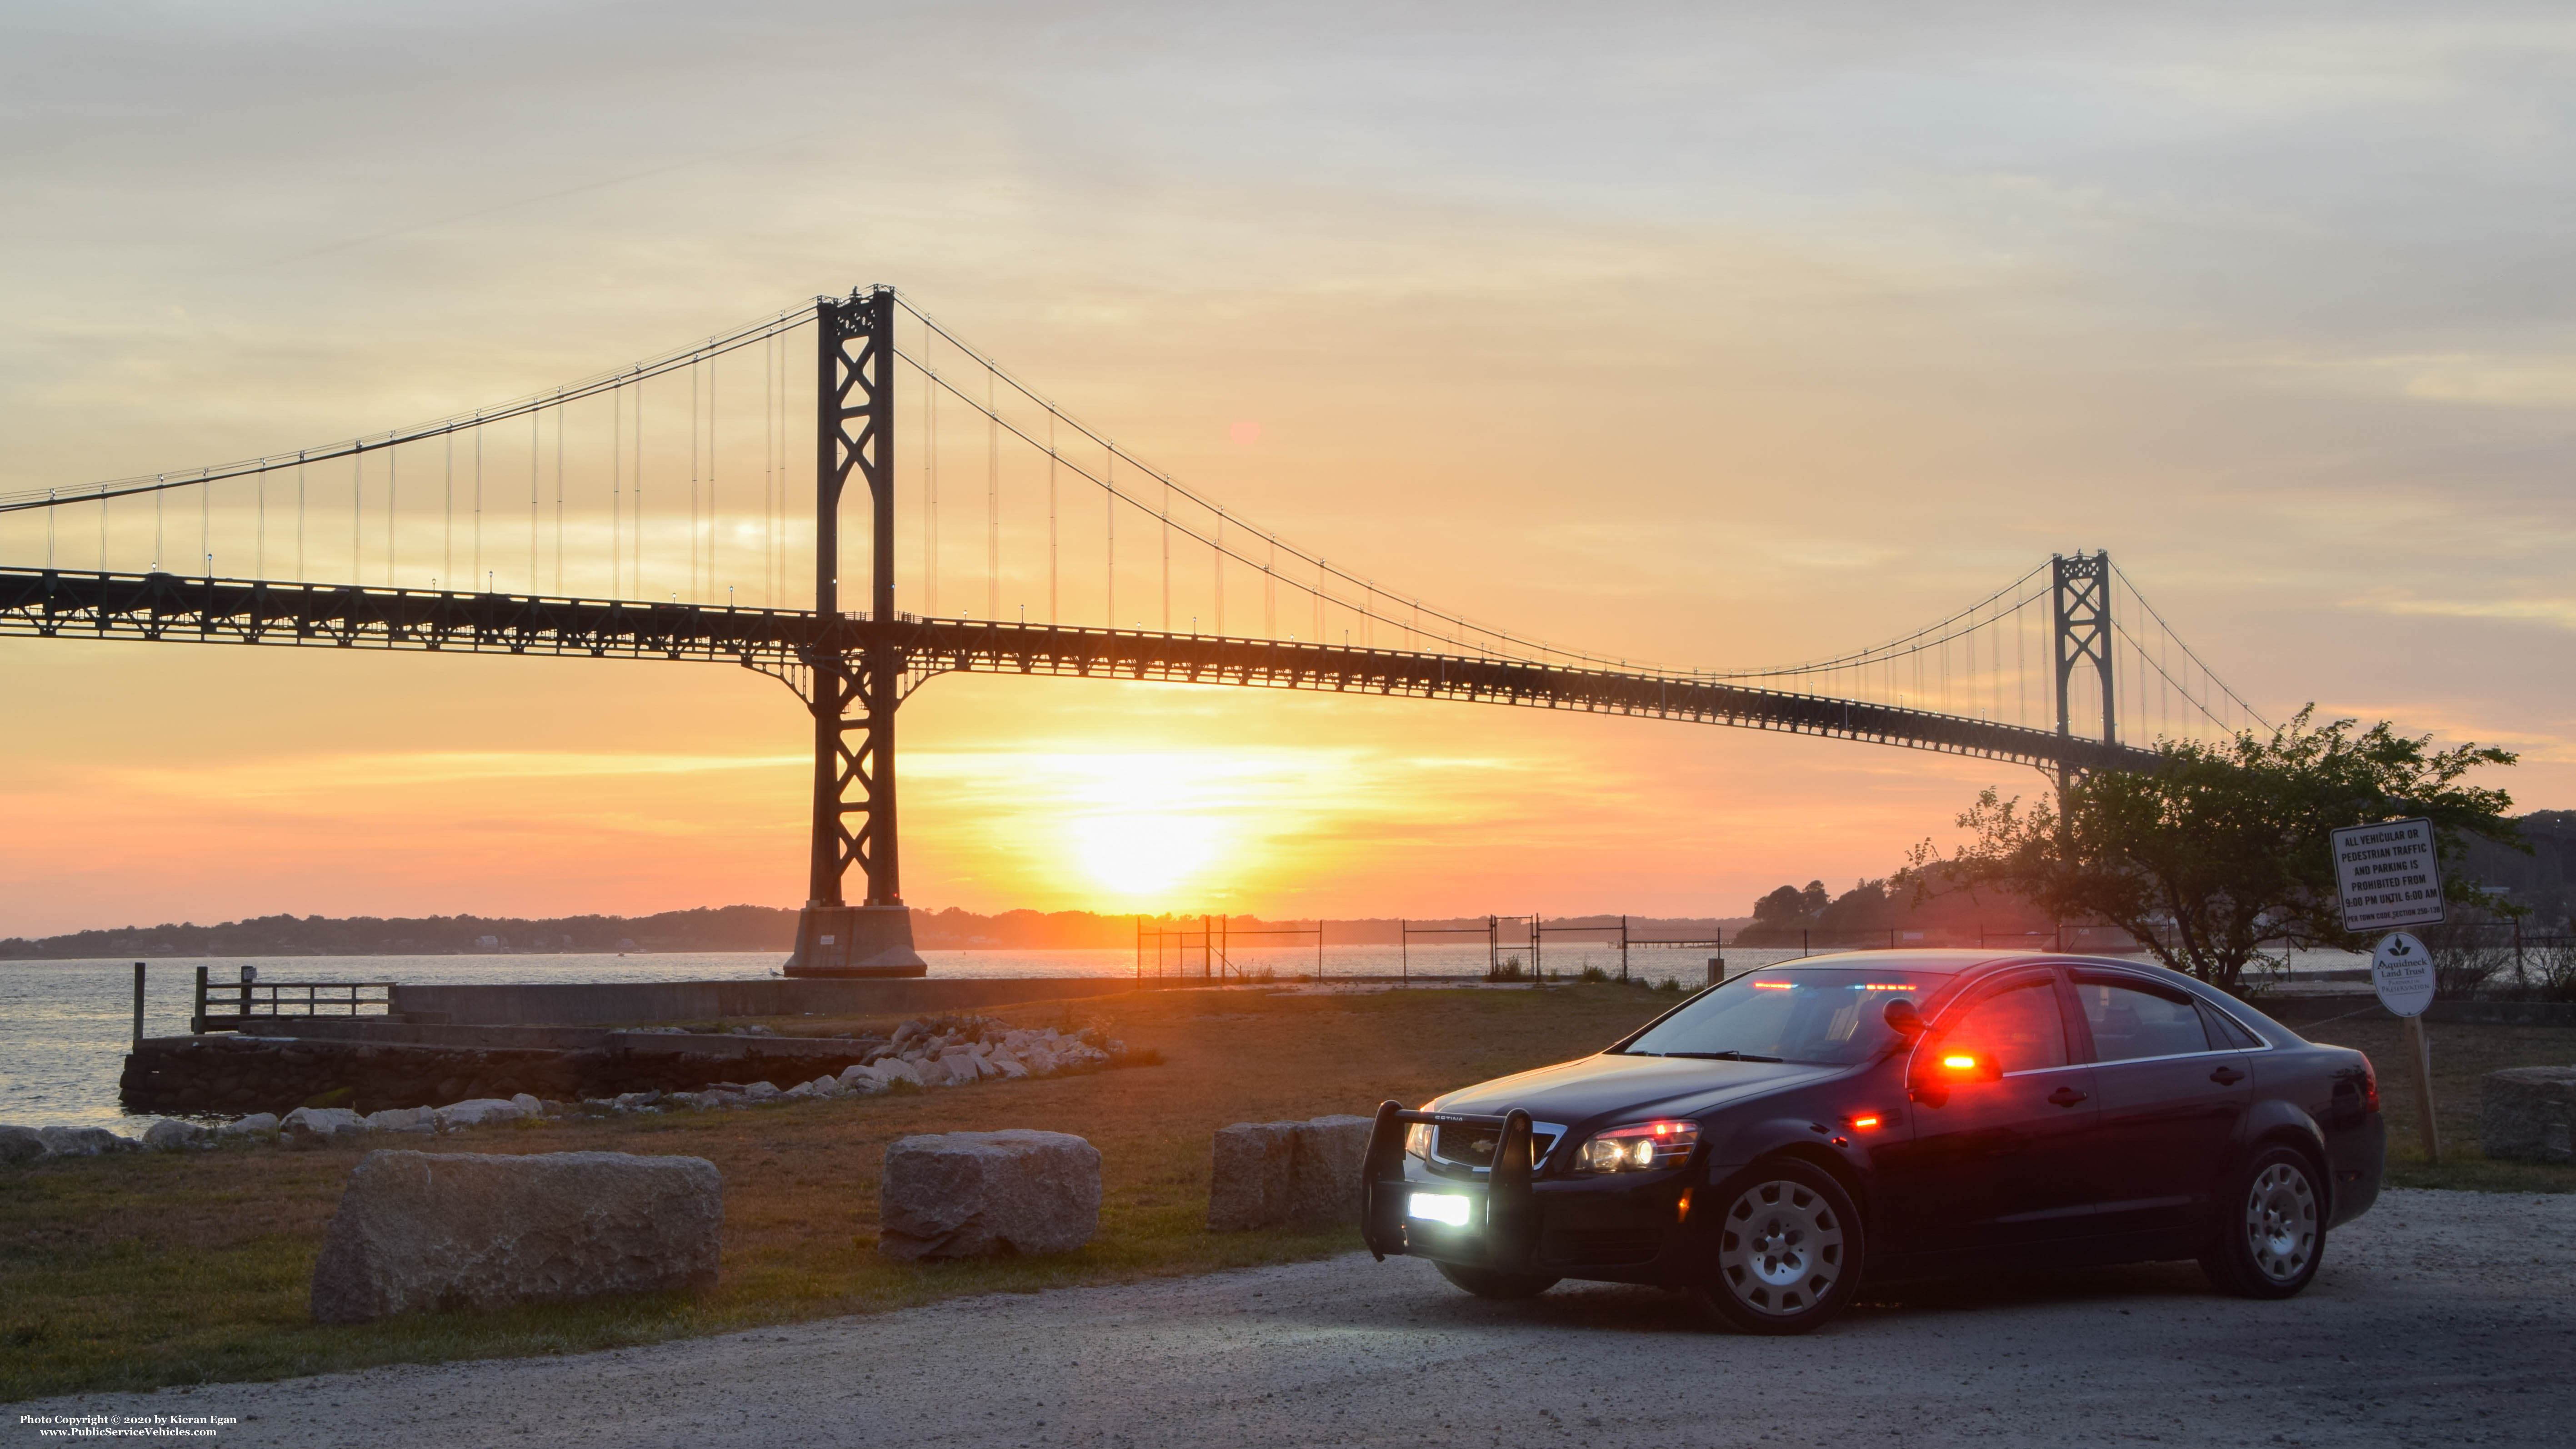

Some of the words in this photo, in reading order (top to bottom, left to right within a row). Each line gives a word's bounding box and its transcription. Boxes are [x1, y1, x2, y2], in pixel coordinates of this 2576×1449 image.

[2345, 836, 2358, 847] ALL
[2360, 831, 2405, 844] VEHICULAR
[2407, 829, 2419, 839] OR
[2342, 849, 2391, 862] PEDESTRIAN
[2393, 843, 2427, 856] TRAFFIC
[2355, 867, 2370, 876] AND
[2373, 860, 2407, 874] PARKING
[2411, 859, 2419, 869] IS
[2351, 878, 2400, 891] PROHIBITED
[2403, 874, 2426, 885] FROM
[2346, 898, 2362, 907] 9:00
[2365, 895, 2377, 905] PM
[2380, 893, 2403, 904] UNTIL
[2405, 890, 2422, 901] 6:00
[2426, 889, 2437, 898] AM
[2392, 909, 2416, 918] SECTION
[2377, 958, 2428, 970] Aquidneck
[2381, 969, 2401, 978] Land
